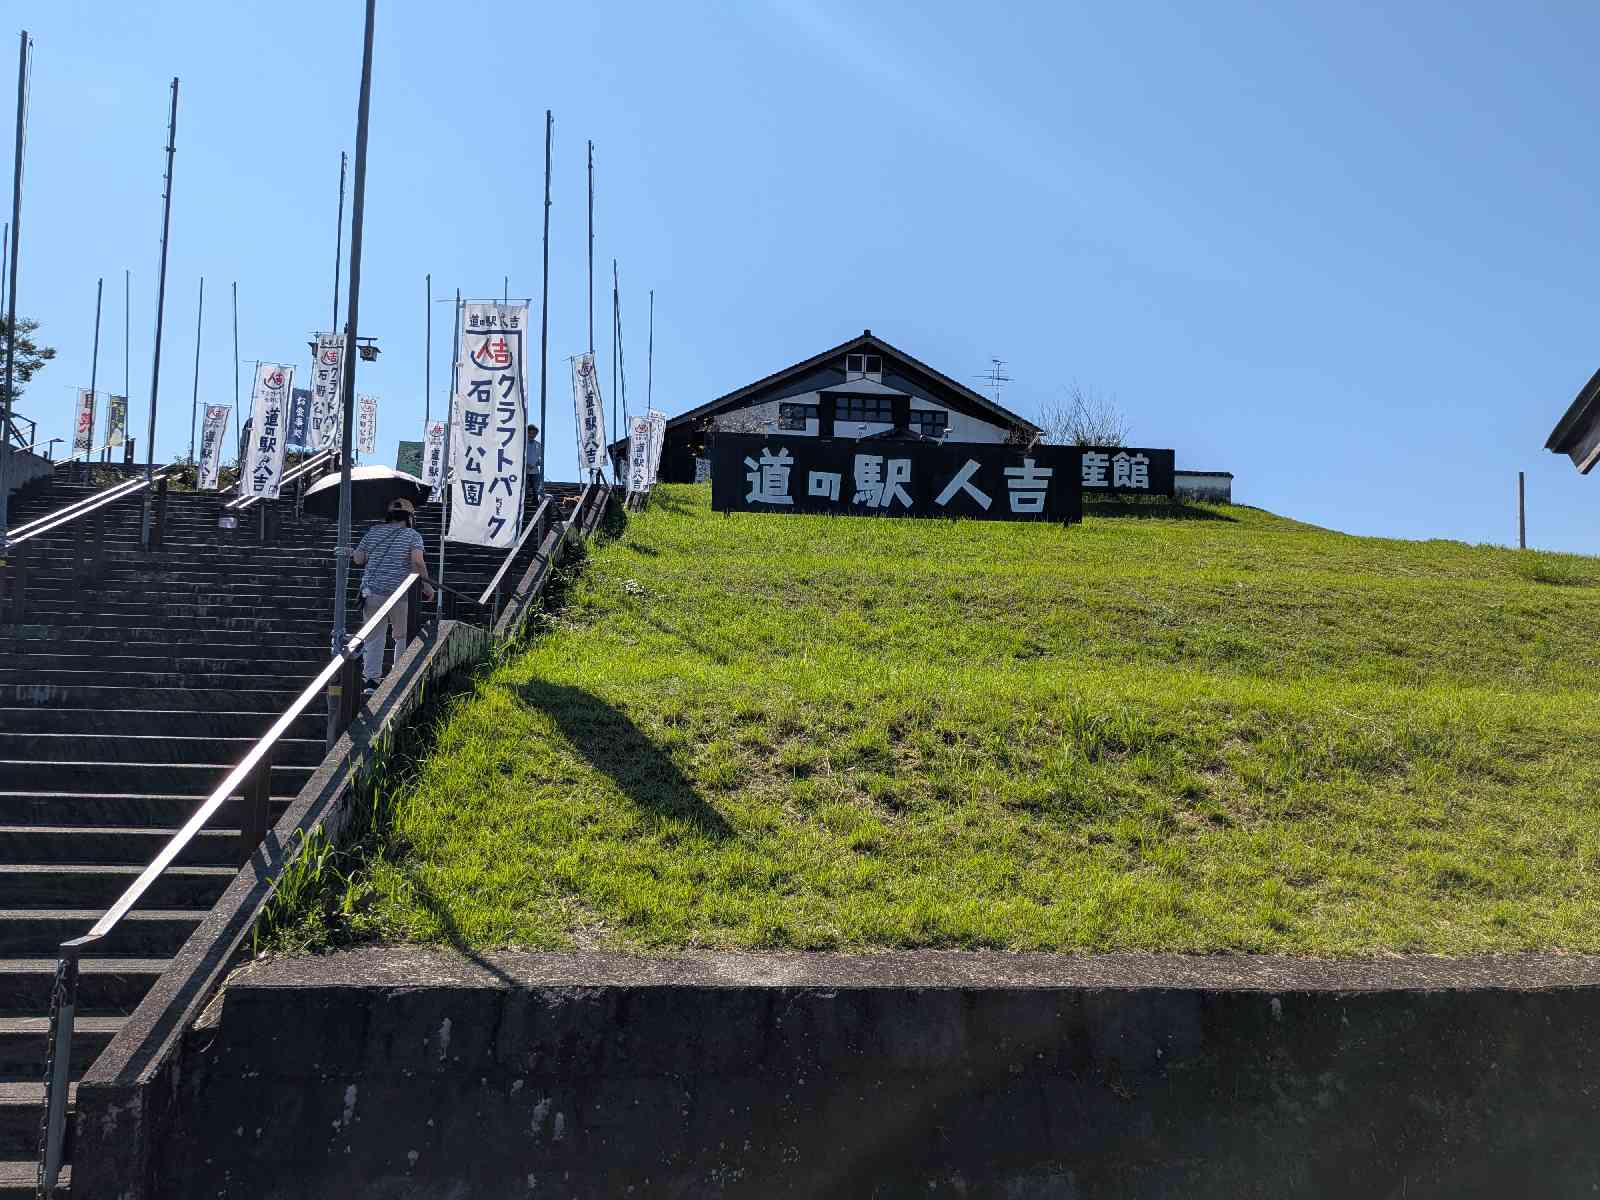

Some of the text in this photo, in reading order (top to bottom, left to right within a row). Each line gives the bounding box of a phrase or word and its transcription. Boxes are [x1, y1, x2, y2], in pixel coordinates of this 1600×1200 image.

[469, 313, 520, 329] 道の駅人吉
[476, 337, 509, 364] 人吉
[460, 379, 494, 507] 石野公園
[488, 374, 518, 540] クラフトパーク
[1081, 450, 1151, 489] 産館
[744, 446, 1054, 514] 道の駅人吉
